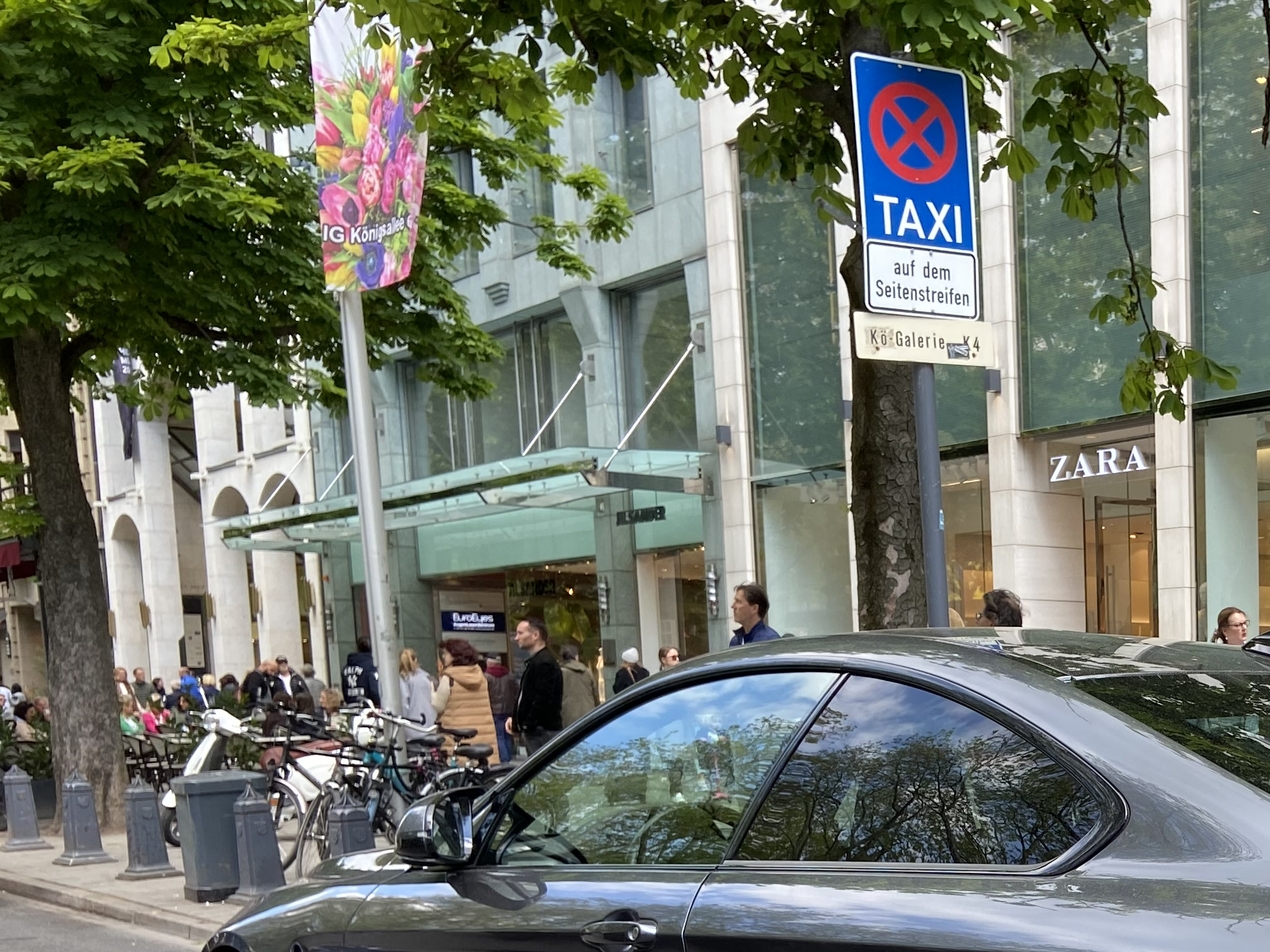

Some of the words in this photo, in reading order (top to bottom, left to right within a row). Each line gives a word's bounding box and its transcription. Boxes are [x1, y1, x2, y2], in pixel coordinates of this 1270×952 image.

[323, 225, 345, 242] IG
[350, 216, 405, 244] Königsallee
[874, 194, 963, 244] TAXI
[894, 260, 915, 277] auf
[923, 262, 951, 281] dem
[876, 279, 969, 307] Seitenstreifen
[870, 328, 945, 350] Kö-Galerie
[973, 336, 980, 352] 4
[1050, 445, 1150, 482] ZARA
